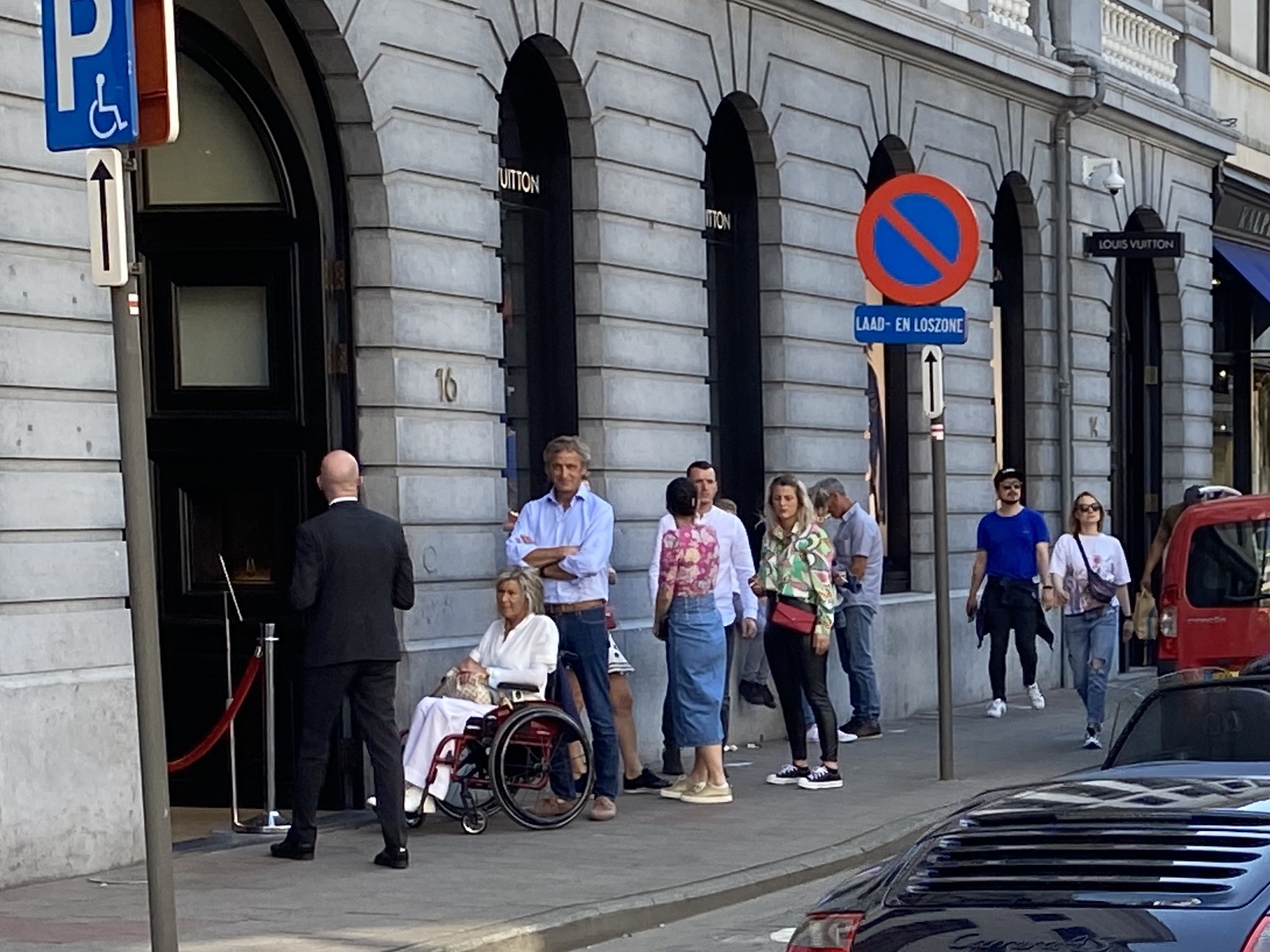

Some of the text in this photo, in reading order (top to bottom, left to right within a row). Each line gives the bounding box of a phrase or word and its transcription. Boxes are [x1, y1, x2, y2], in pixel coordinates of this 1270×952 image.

[54, 0, 113, 112] P
[498, 166, 540, 194] UITTON
[1099, 239, 1174, 249] LOUIS VUITTON
[855, 316, 964, 333] LAAD- EN LOSZONE
[435, 366, 457, 402] 16
